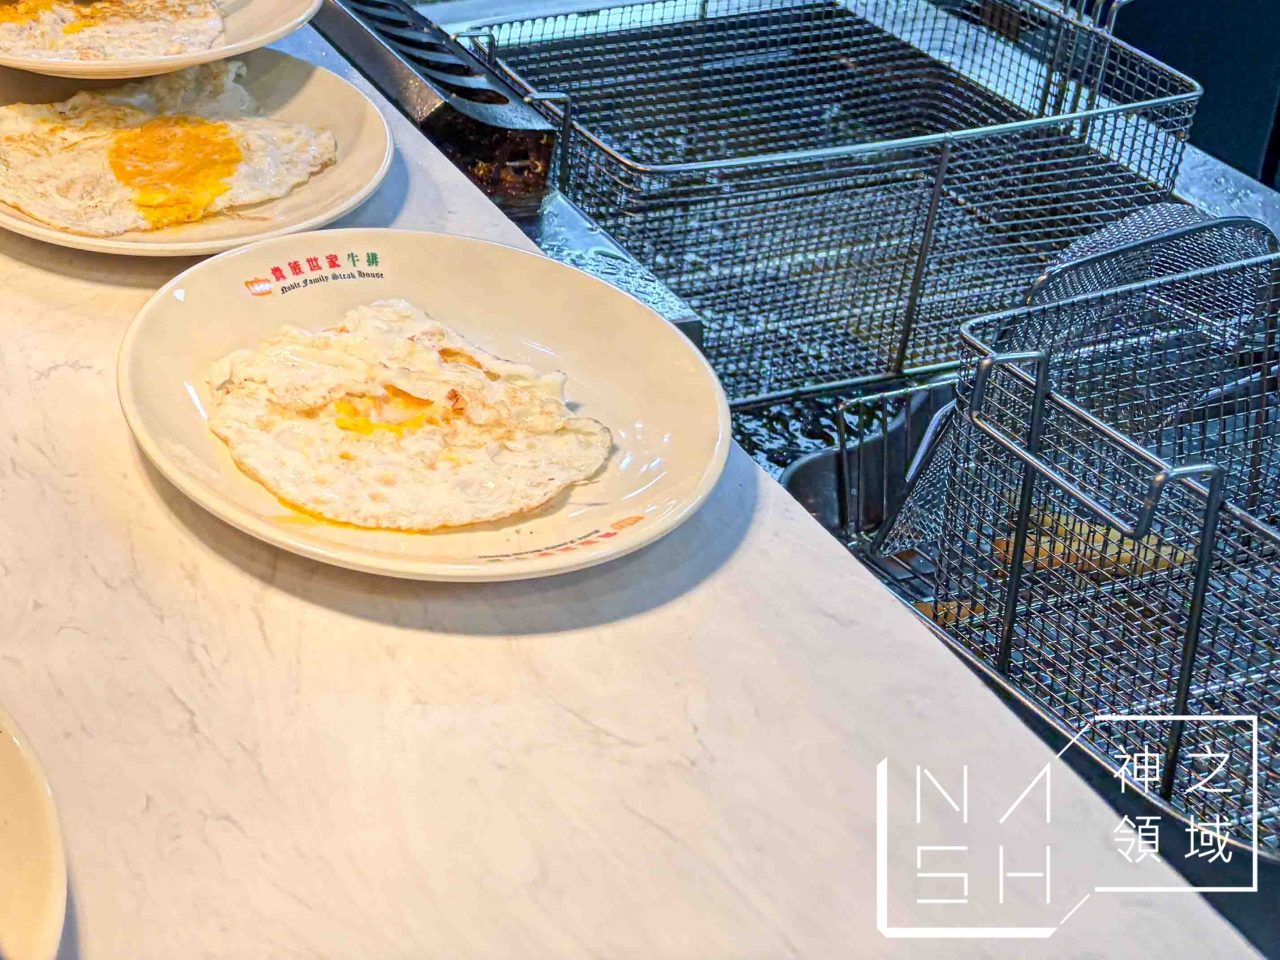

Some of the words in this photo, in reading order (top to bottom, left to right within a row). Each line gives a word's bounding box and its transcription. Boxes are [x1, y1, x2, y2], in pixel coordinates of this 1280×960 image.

[281, 282, 301, 295] Noble
[302, 275, 330, 288] Family
[331, 271, 357, 281] Steak
[358, 269, 384, 280] House
